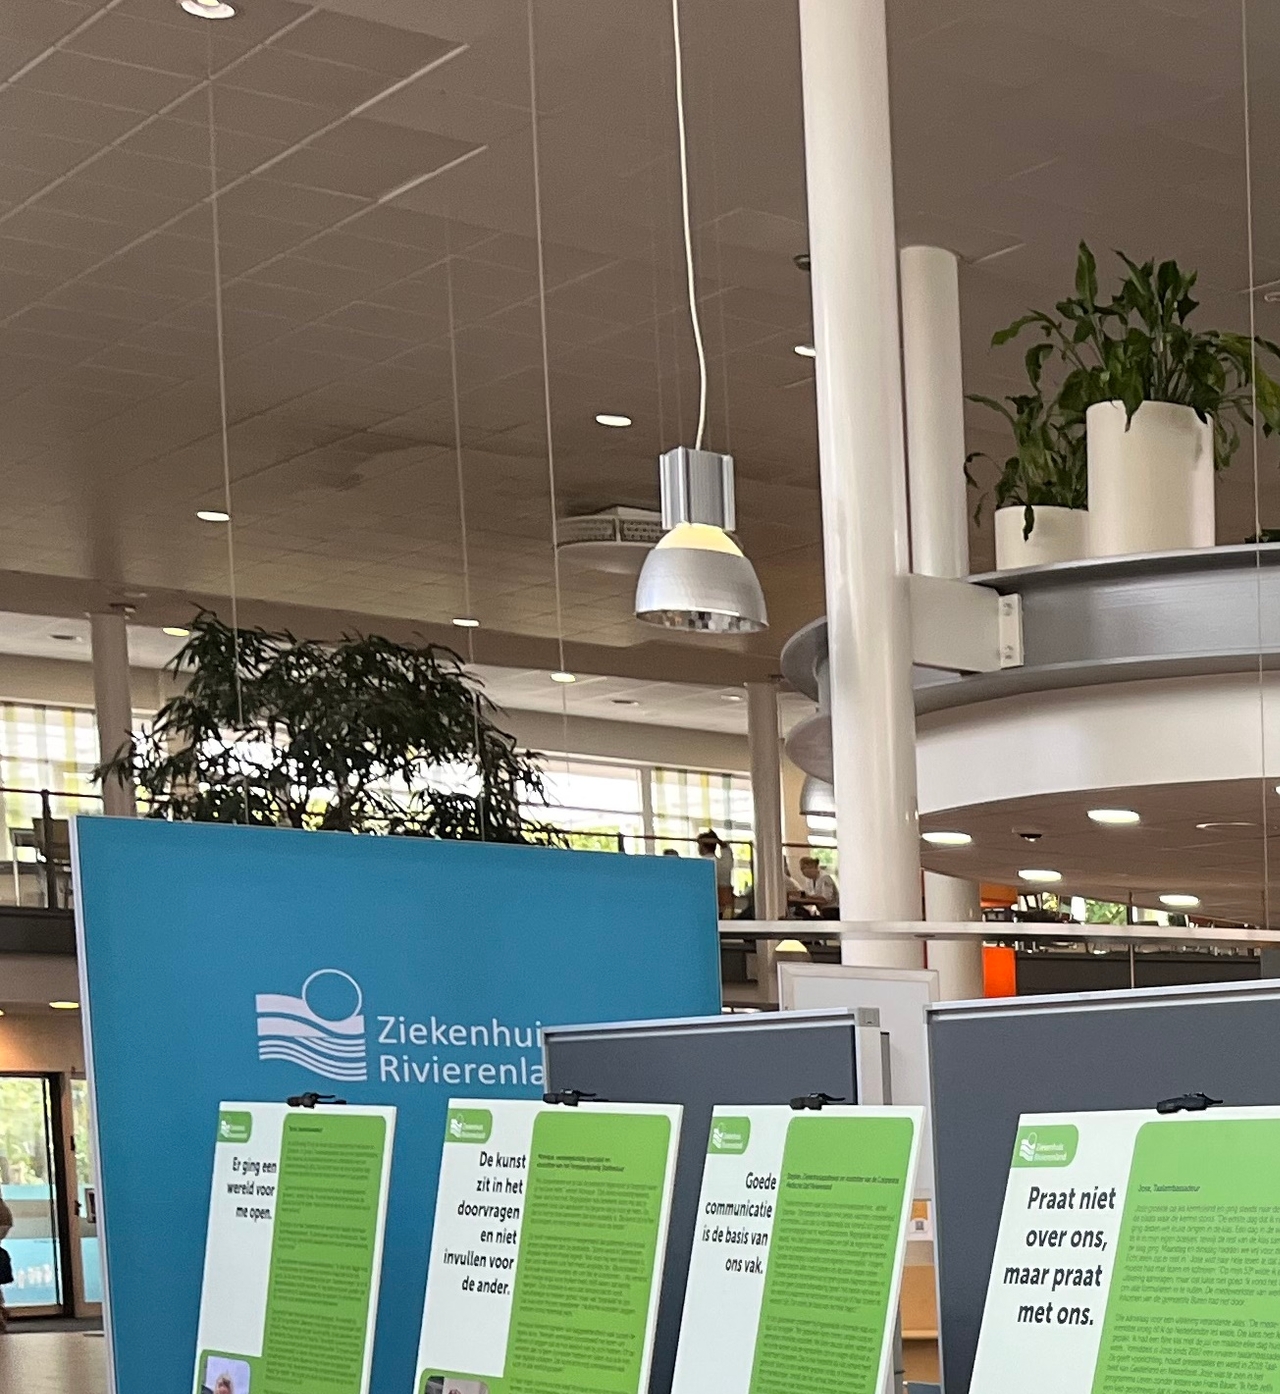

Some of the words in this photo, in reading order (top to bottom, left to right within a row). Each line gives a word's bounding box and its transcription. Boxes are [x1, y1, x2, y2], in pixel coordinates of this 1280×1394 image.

[377, 1016, 542, 1047] Ziekenhui
[380, 1055, 545, 1085] Rivierenla
[232, 1156, 242, 1172] Er
[242, 1159, 261, 1177] ging
[262, 1162, 277, 1173] een
[479, 1151, 494, 1168] De
[495, 1152, 527, 1169] kunst
[227, 1181, 255, 1196] wereld
[256, 1185, 276, 1196] voor
[476, 1177, 491, 1192] zit
[492, 1177, 503, 1193] in
[505, 1178, 523, 1195] het
[745, 1171, 777, 1191] Goede
[1027, 1186, 1076, 1210] Praat
[1079, 1186, 1117, 1210] niet
[236, 1207, 248, 1218] me
[249, 1207, 272, 1222] open.
[457, 1200, 520, 1223] doorvragen
[705, 1200, 773, 1219] communicatie
[480, 1230, 494, 1243] en
[495, 1228, 517, 1245] niet
[702, 1225, 711, 1242] is
[711, 1226, 724, 1243] de
[725, 1226, 749, 1245] basis
[751, 1233, 769, 1246] van
[1026, 1229, 1068, 1248] over
[1070, 1230, 1108, 1252] ons,
[443, 1250, 487, 1268] invullen
[489, 1256, 515, 1270] voor
[725, 1258, 743, 1273] ons
[744, 1256, 763, 1274] vak.
[461, 1275, 475, 1292] de
[476, 1278, 510, 1295] ander.
[1003, 1267, 1050, 1285] maar
[1051, 1264, 1103, 1292] praat
[1017, 1302, 1054, 1324] met
[1057, 1307, 1094, 1326] ons.
